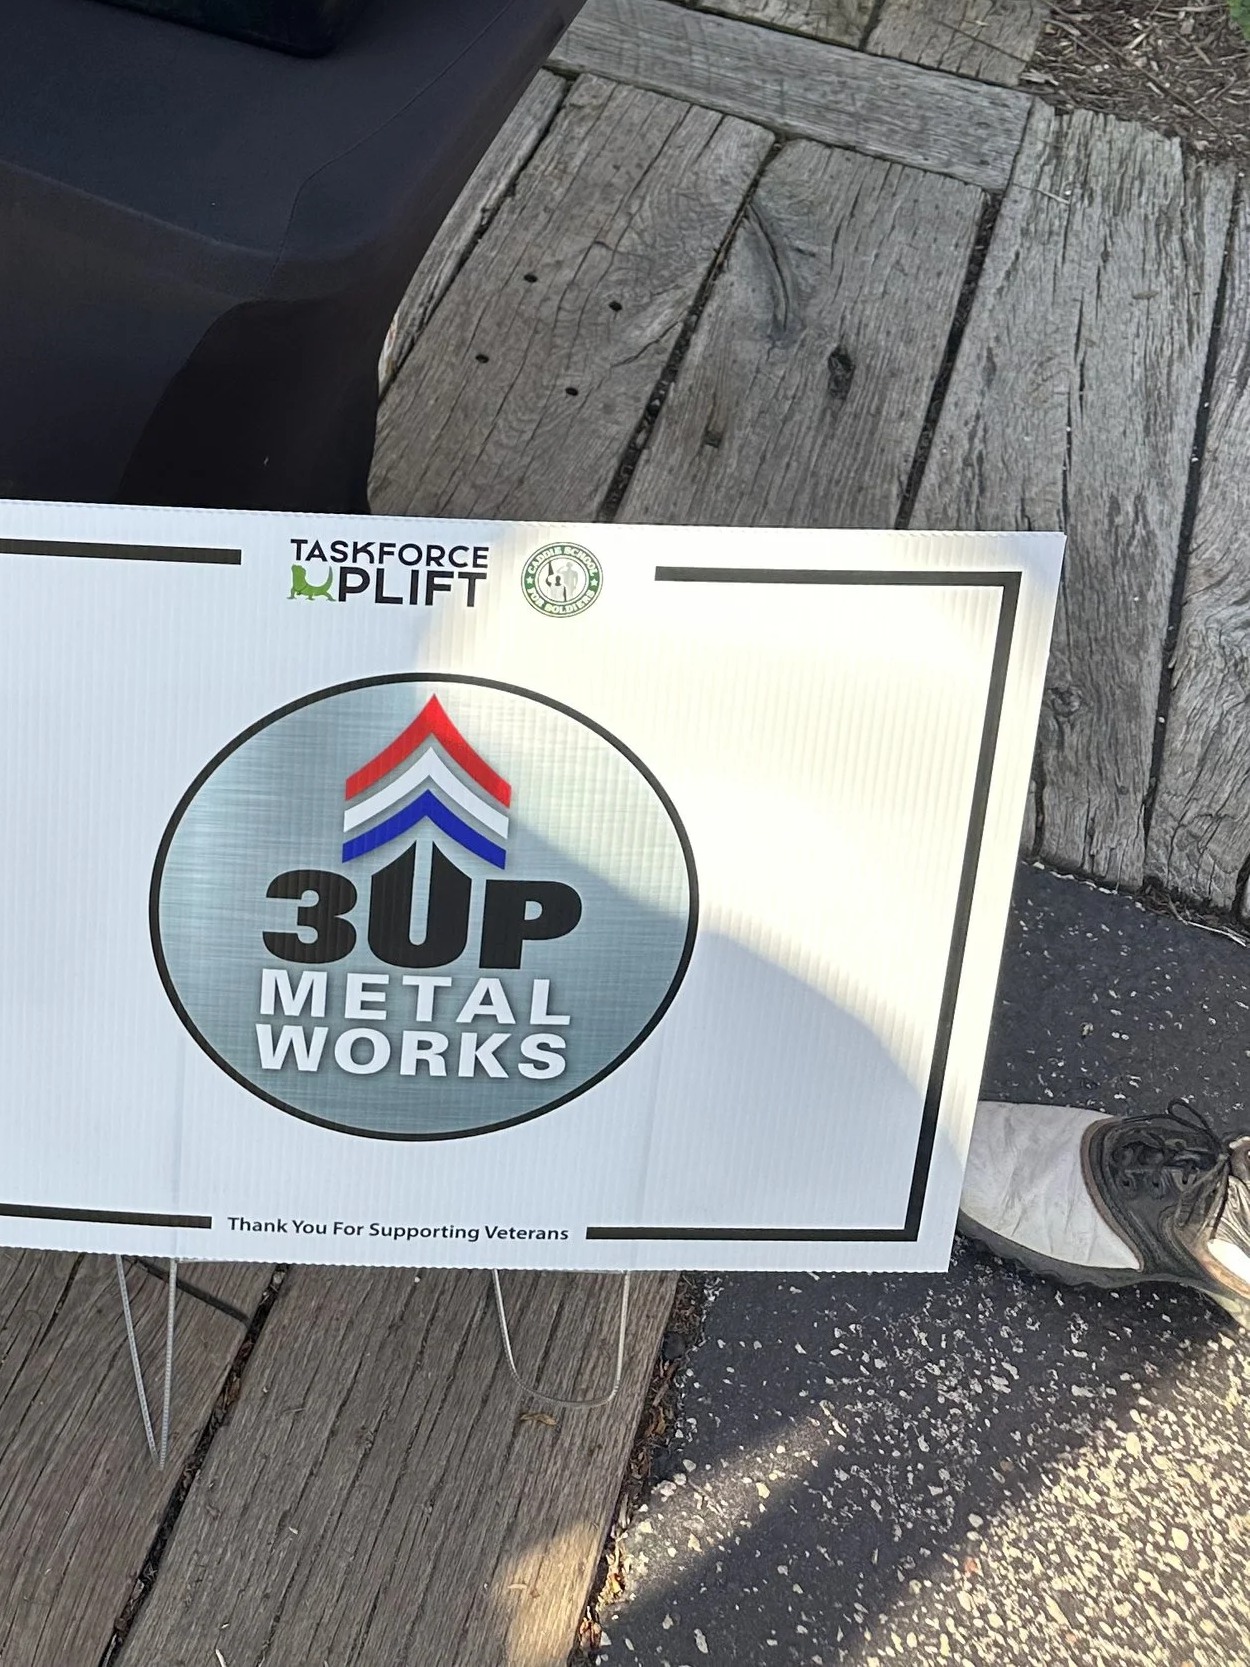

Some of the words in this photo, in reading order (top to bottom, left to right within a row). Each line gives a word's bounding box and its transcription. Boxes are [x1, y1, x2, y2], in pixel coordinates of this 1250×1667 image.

[291, 538, 490, 569] TASKFORCE
[527, 546, 562, 575] CADDIE
[563, 546, 599, 576] SCHOOL
[526, 586, 545, 608] FOR
[543, 588, 596, 614] SOLDIERS
[262, 840, 583, 970] 3UP
[260, 968, 571, 1025] METAL
[255, 1024, 567, 1080] WORKS
[228, 1216, 288, 1234] Thank
[292, 1220, 327, 1235] You
[333, 1221, 364, 1236] For
[369, 1222, 480, 1242] Supporting
[485, 1225, 569, 1241] Veterans
